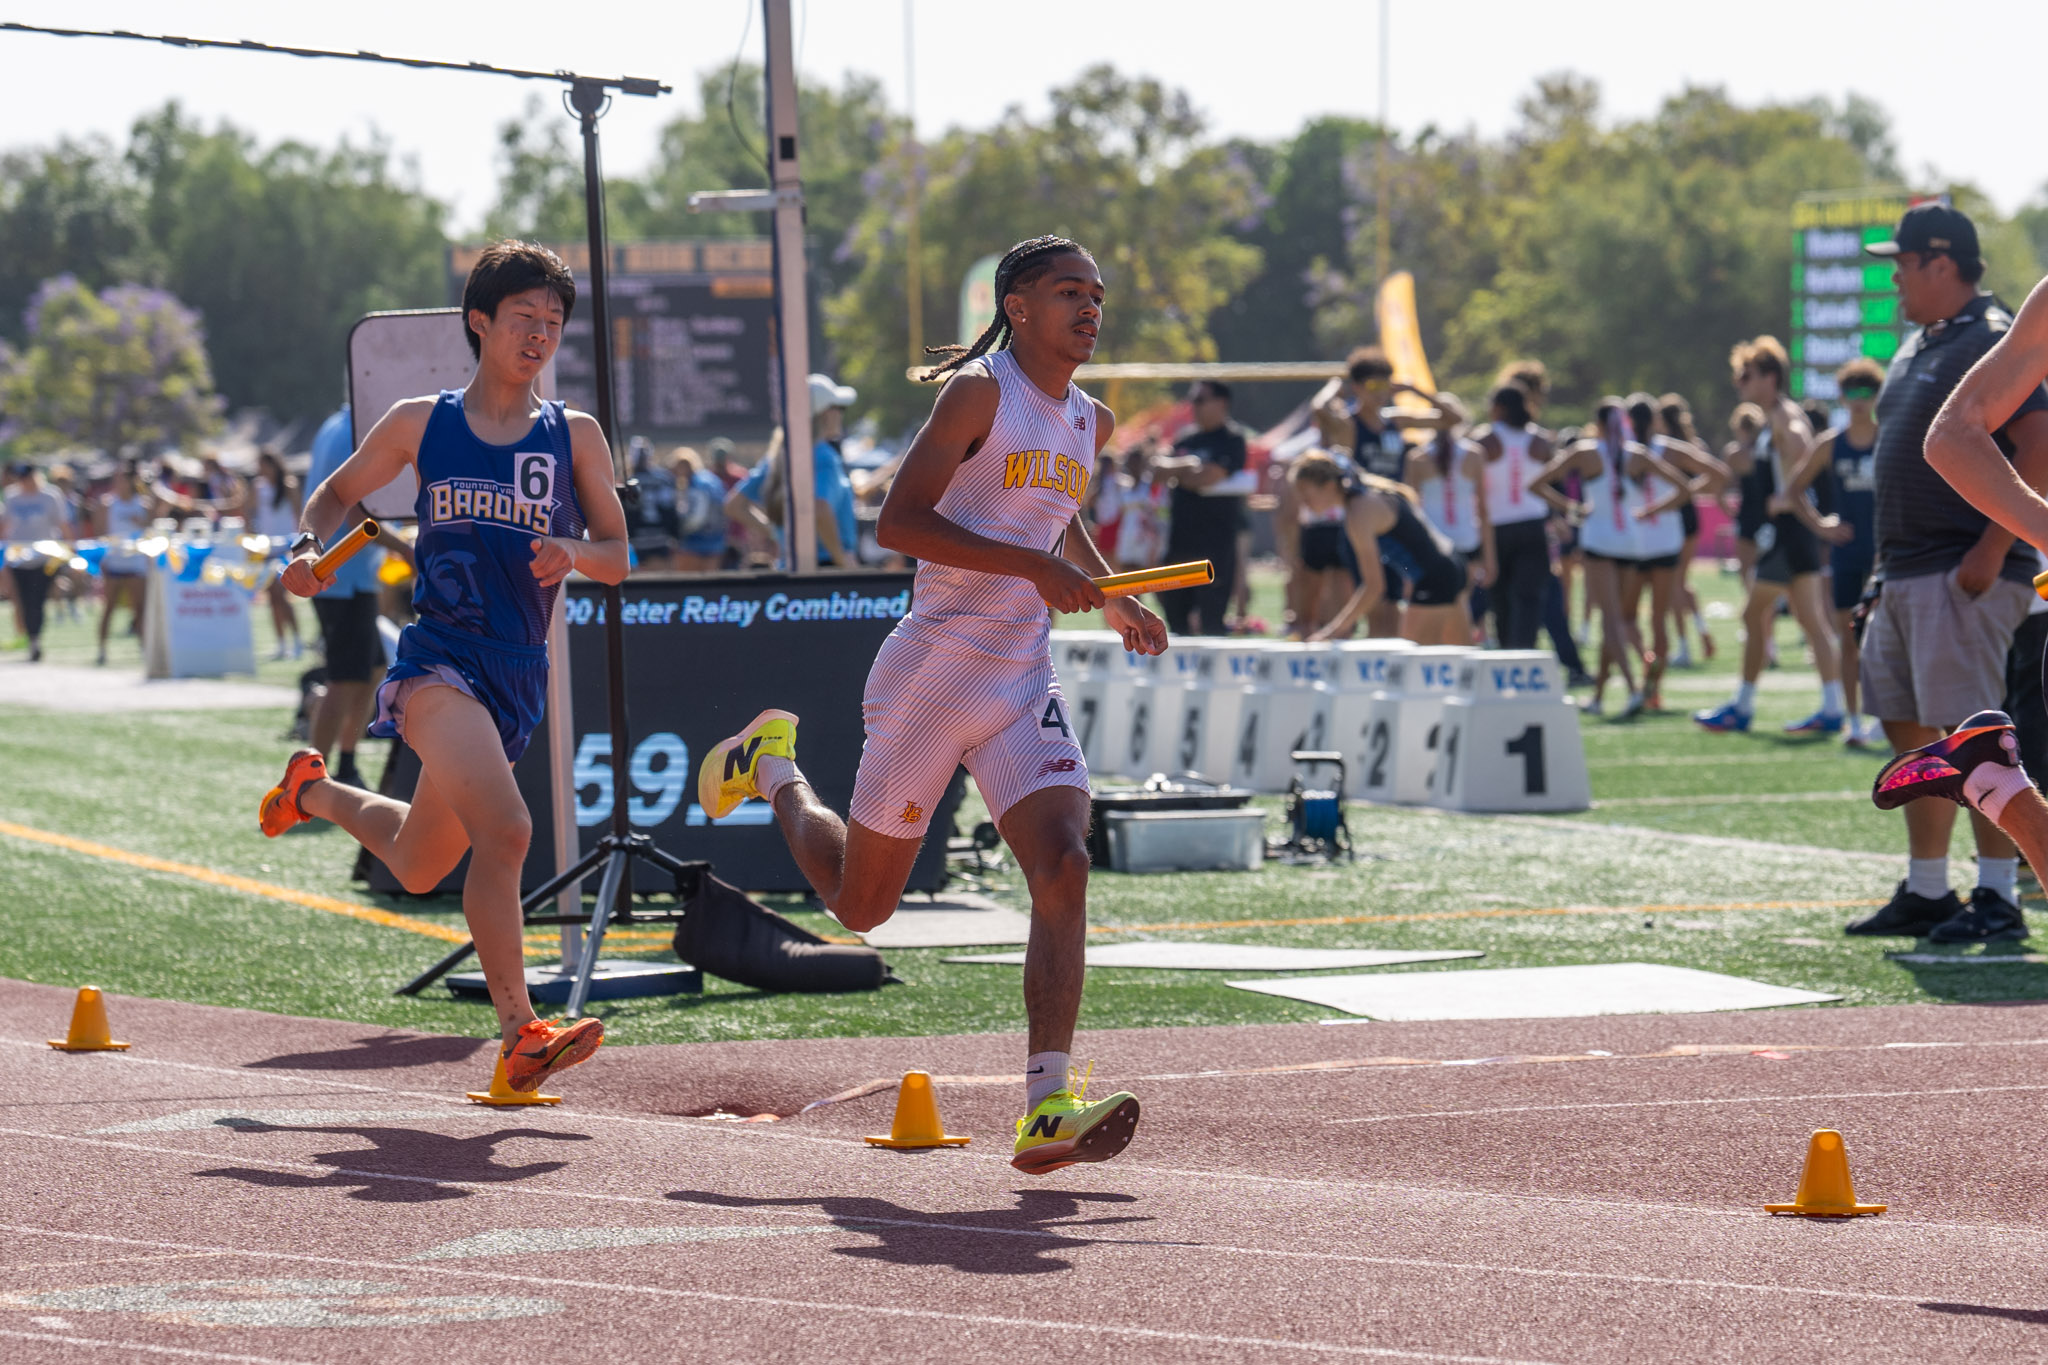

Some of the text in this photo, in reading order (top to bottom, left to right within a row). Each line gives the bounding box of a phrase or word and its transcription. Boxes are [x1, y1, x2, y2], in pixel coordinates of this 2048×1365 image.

[453, 481, 499, 492] FOUNTAIN
[520, 456, 549, 500] 6
[1003, 450, 1089, 506] WILSON
[432, 484, 550, 535] BARONS
[680, 594, 761, 628] Relay
[765, 589, 911, 621] Combined
[1041, 697, 1070, 738] 4
[1367, 720, 1391, 788] 2
[1504, 724, 1547, 795] 1
[1027, 1114, 1064, 1138] N
